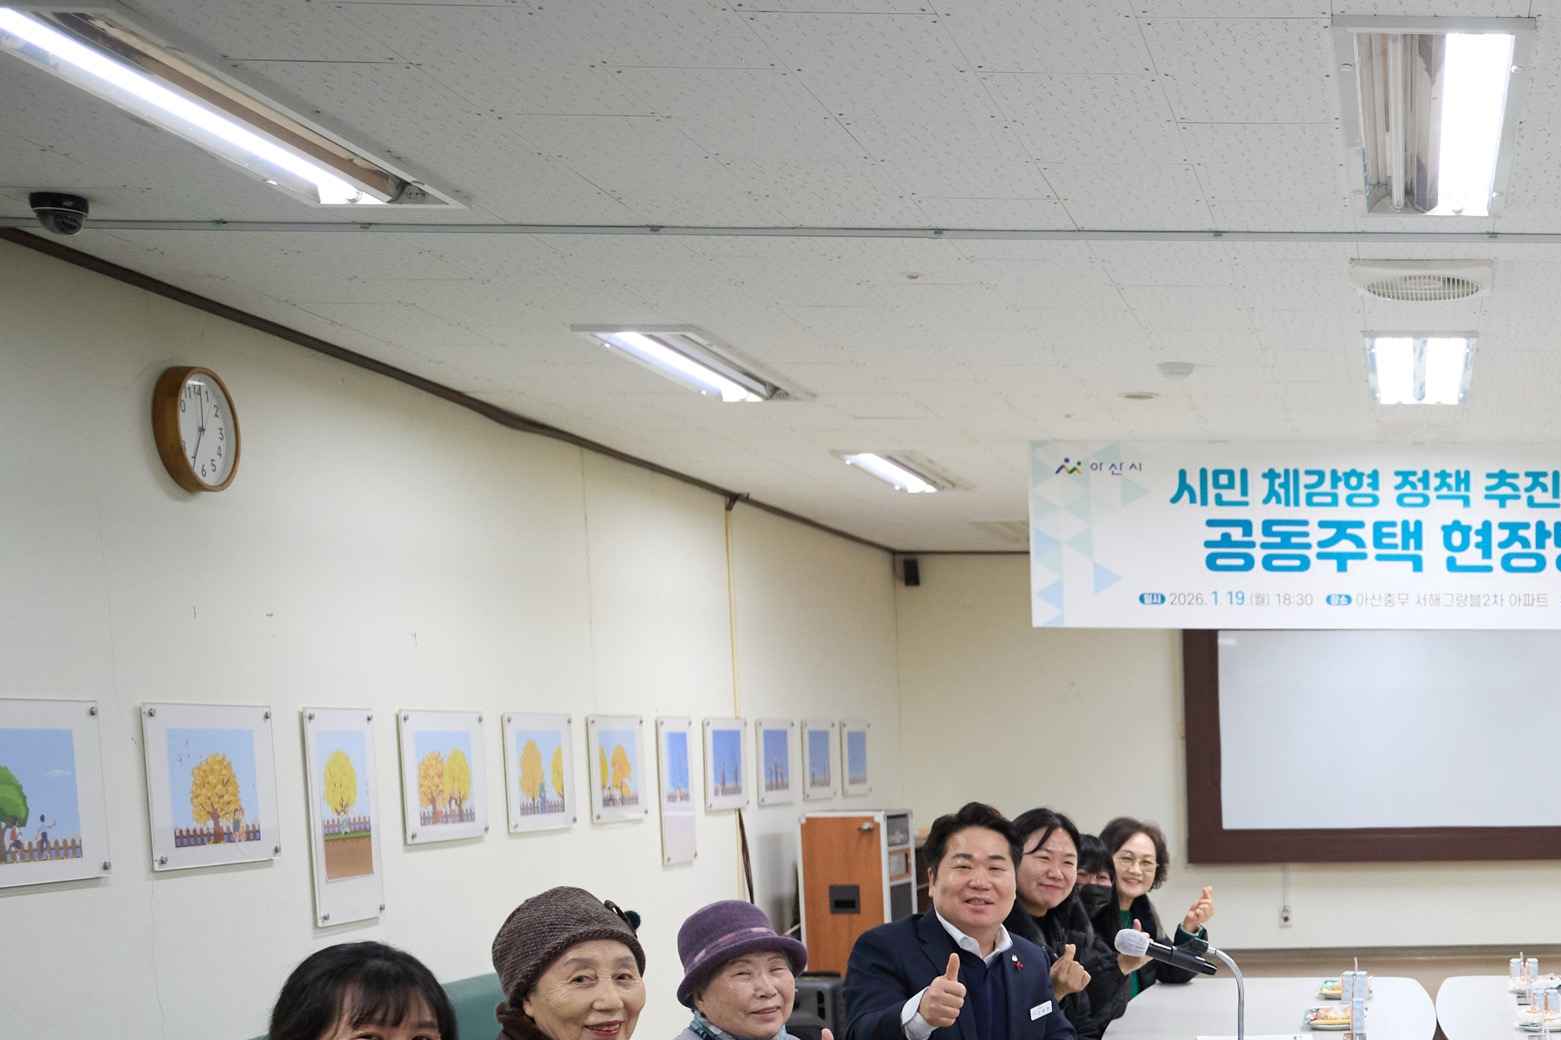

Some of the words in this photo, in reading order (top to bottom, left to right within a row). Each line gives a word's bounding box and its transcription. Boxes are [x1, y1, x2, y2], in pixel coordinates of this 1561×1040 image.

[1090, 462, 1143, 476] 아산시
[1169, 466, 1250, 508] 시민
[1260, 466, 1380, 510] 체감형
[1392, 467, 1473, 510] 정책
[1201, 517, 1425, 574] 공동주택
[1276, 592, 1314, 606] 18:30
[1508, 592, 1549, 608] 아파트
